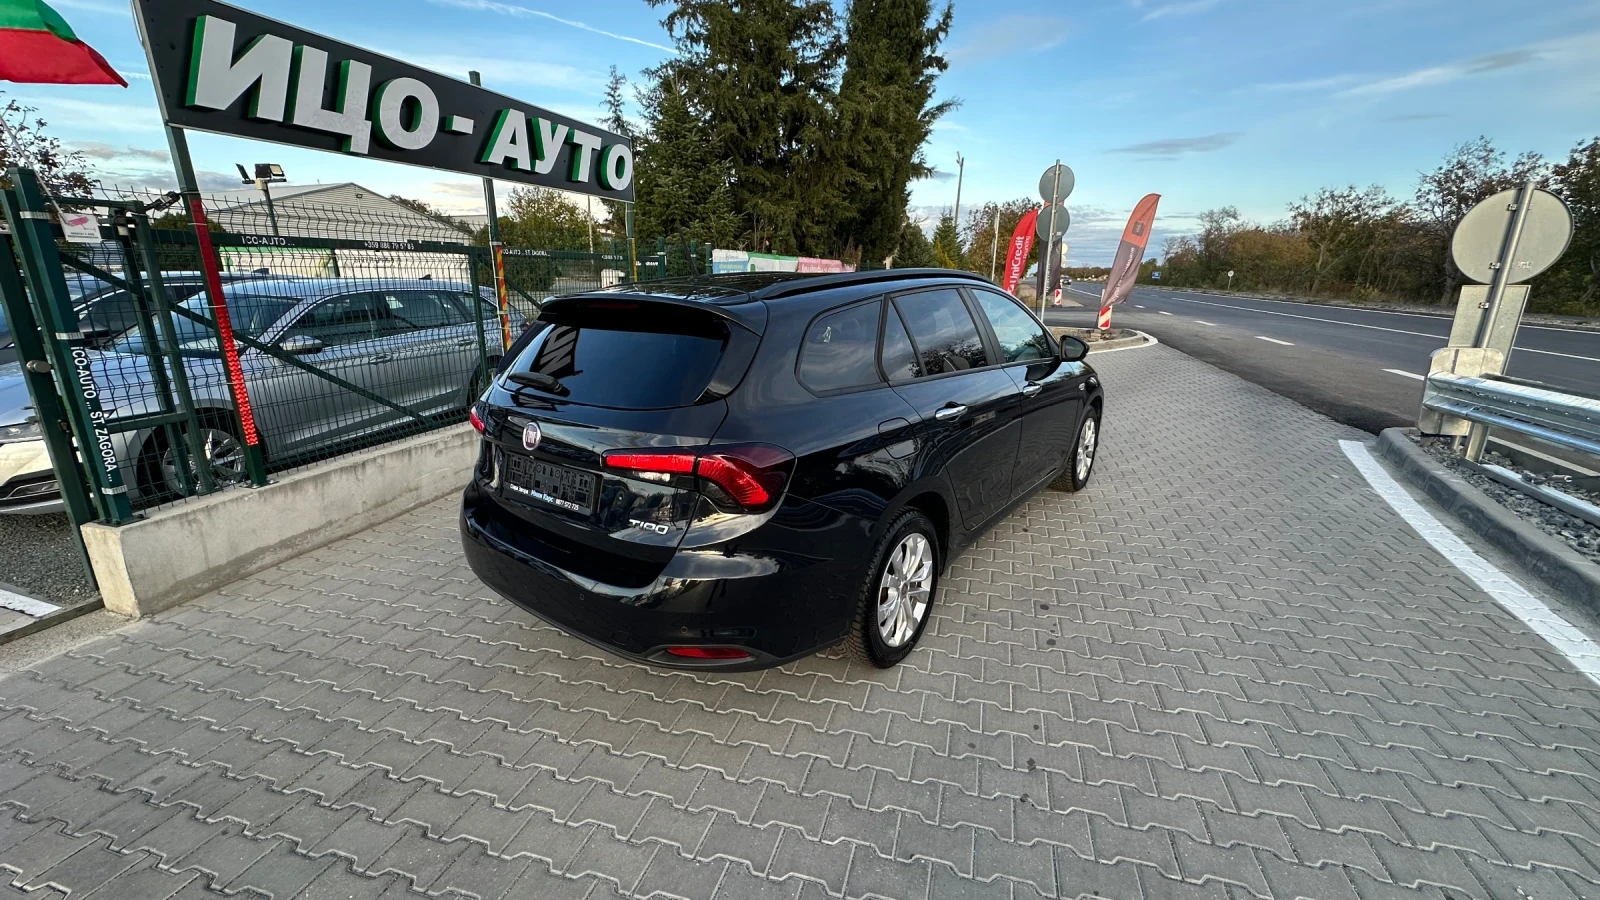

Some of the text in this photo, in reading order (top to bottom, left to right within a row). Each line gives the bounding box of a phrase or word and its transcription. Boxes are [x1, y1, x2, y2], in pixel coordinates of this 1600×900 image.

[1009, 235, 1025, 285] UniCredit
[90, 411, 105, 427] ST.
[95, 428, 118, 472] ZAGORA
